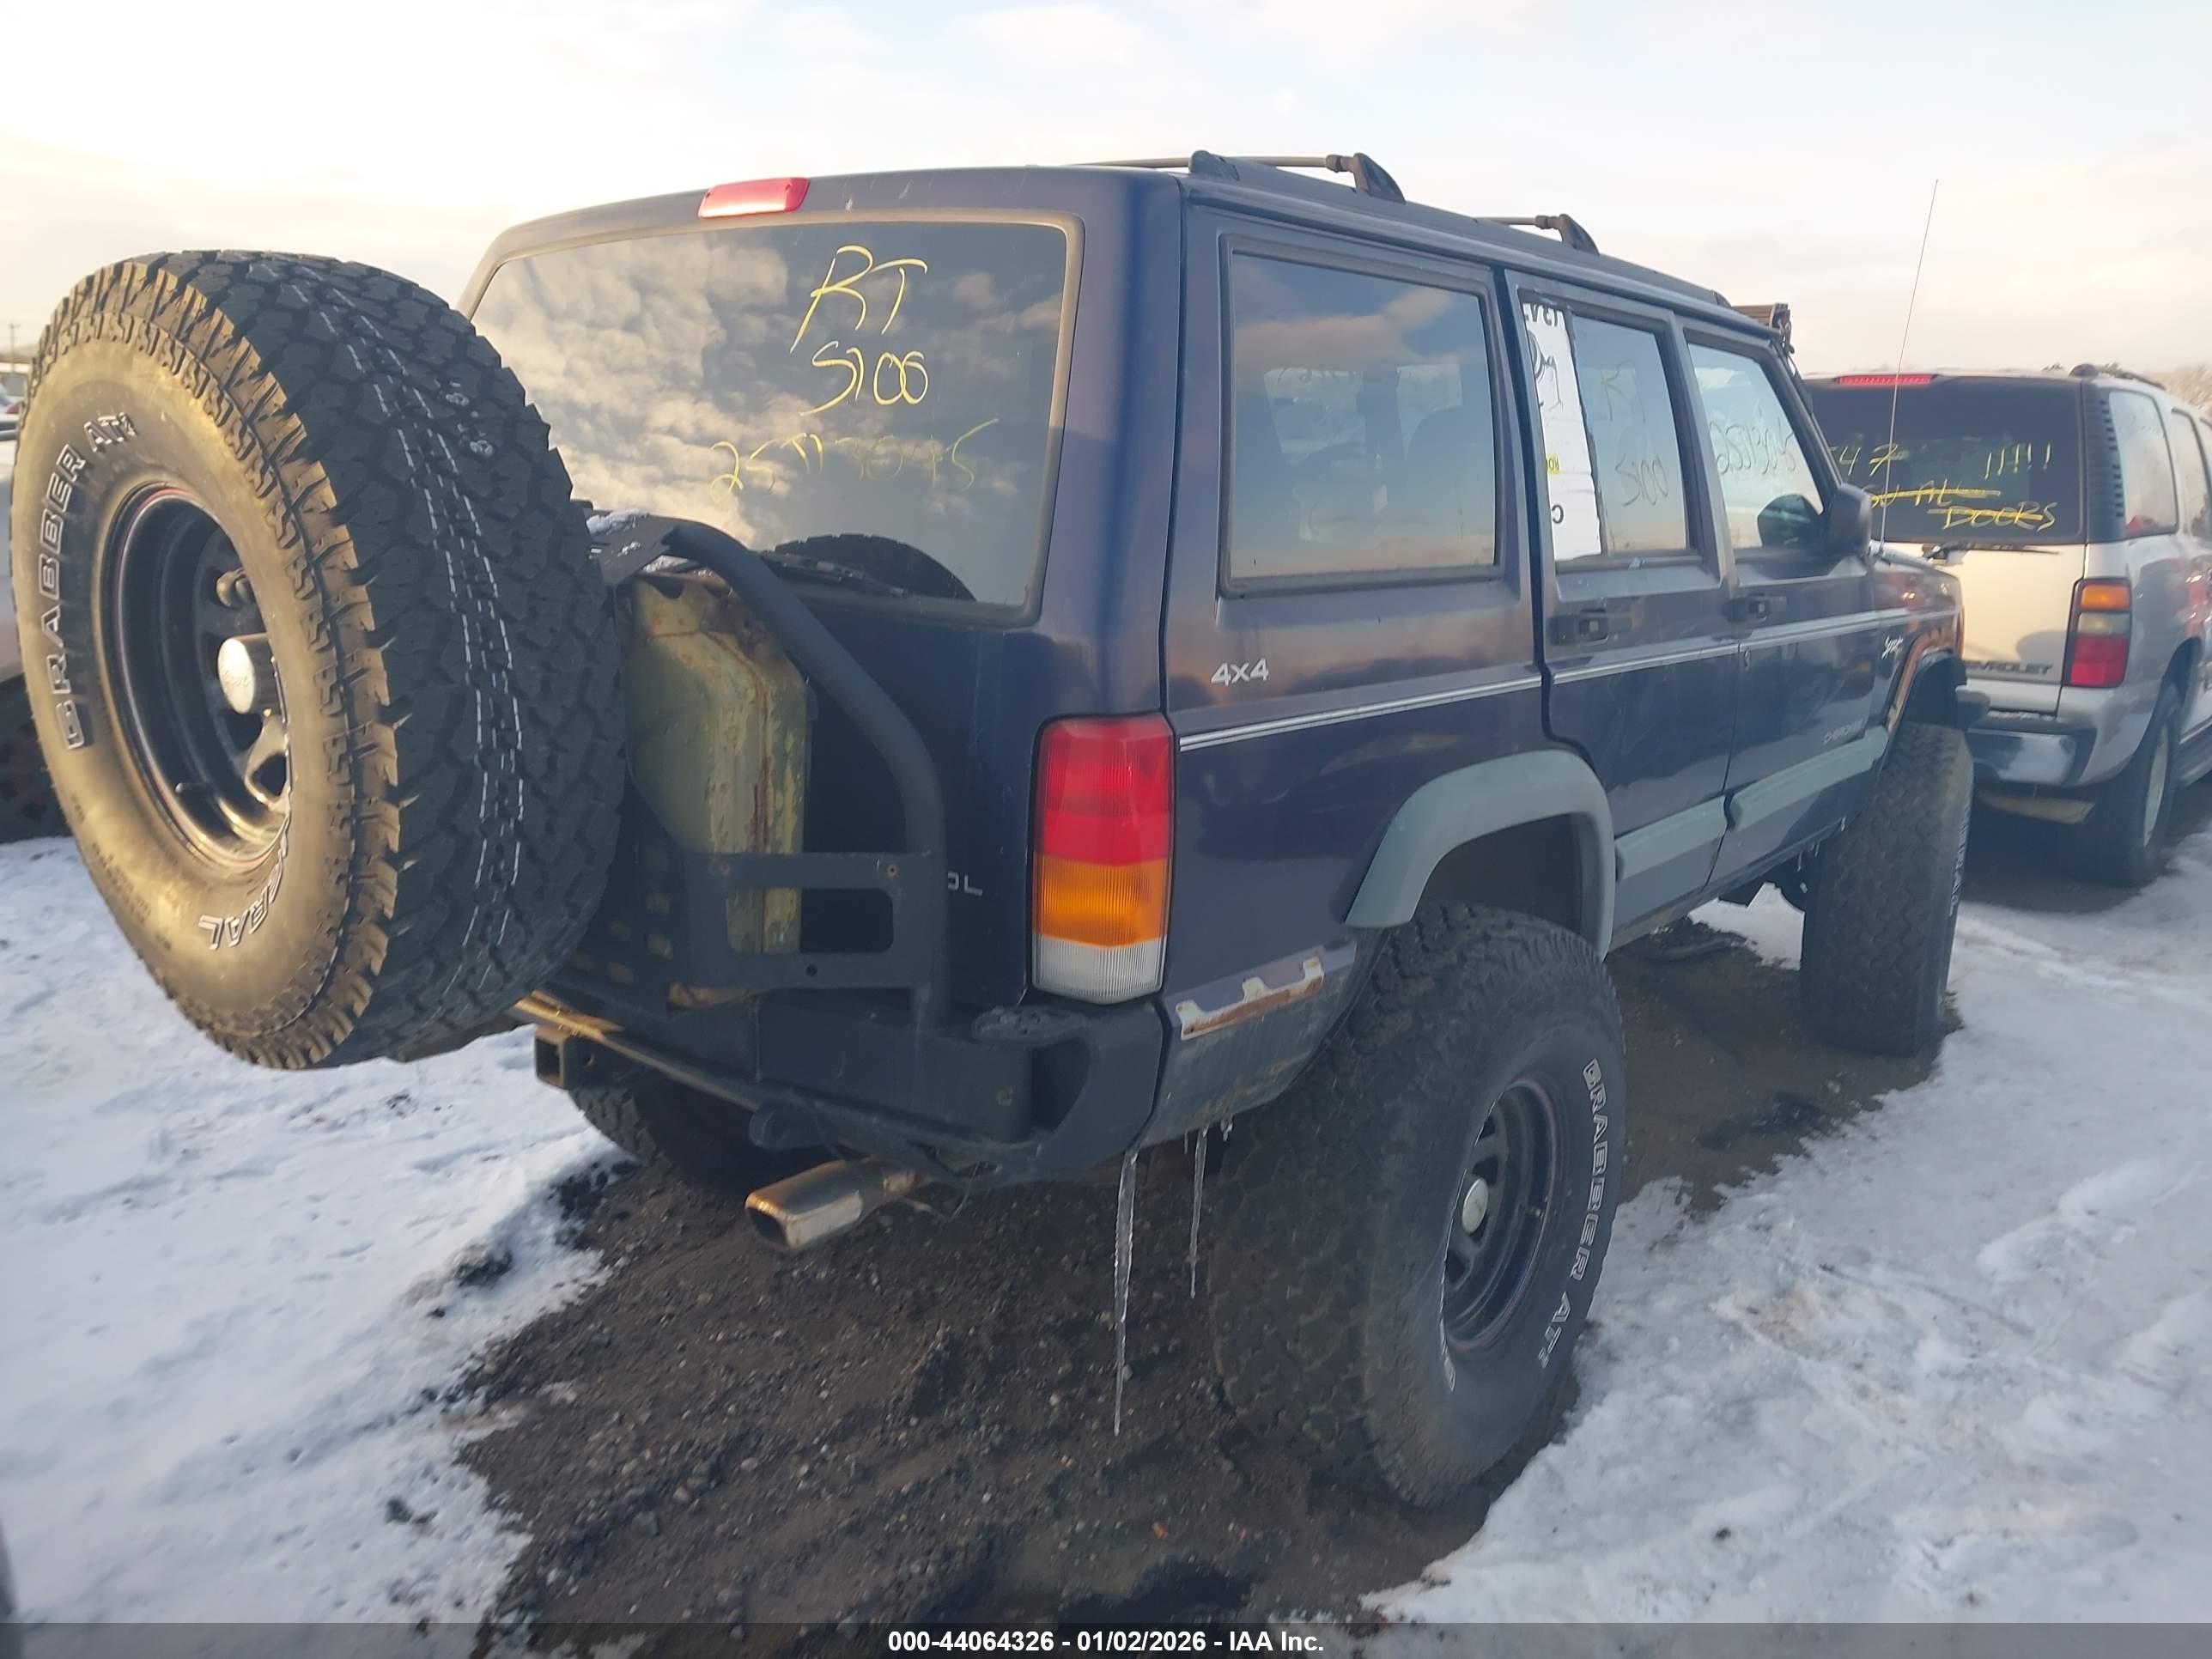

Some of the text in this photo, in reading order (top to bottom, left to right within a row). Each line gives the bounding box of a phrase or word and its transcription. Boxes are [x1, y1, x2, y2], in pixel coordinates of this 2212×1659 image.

[790, 245, 928, 354] RT
[39, 444, 86, 750] GRABBER
[1942, 501, 2057, 532] DOORS
[1569, 1058, 1609, 1281] GRABBER
